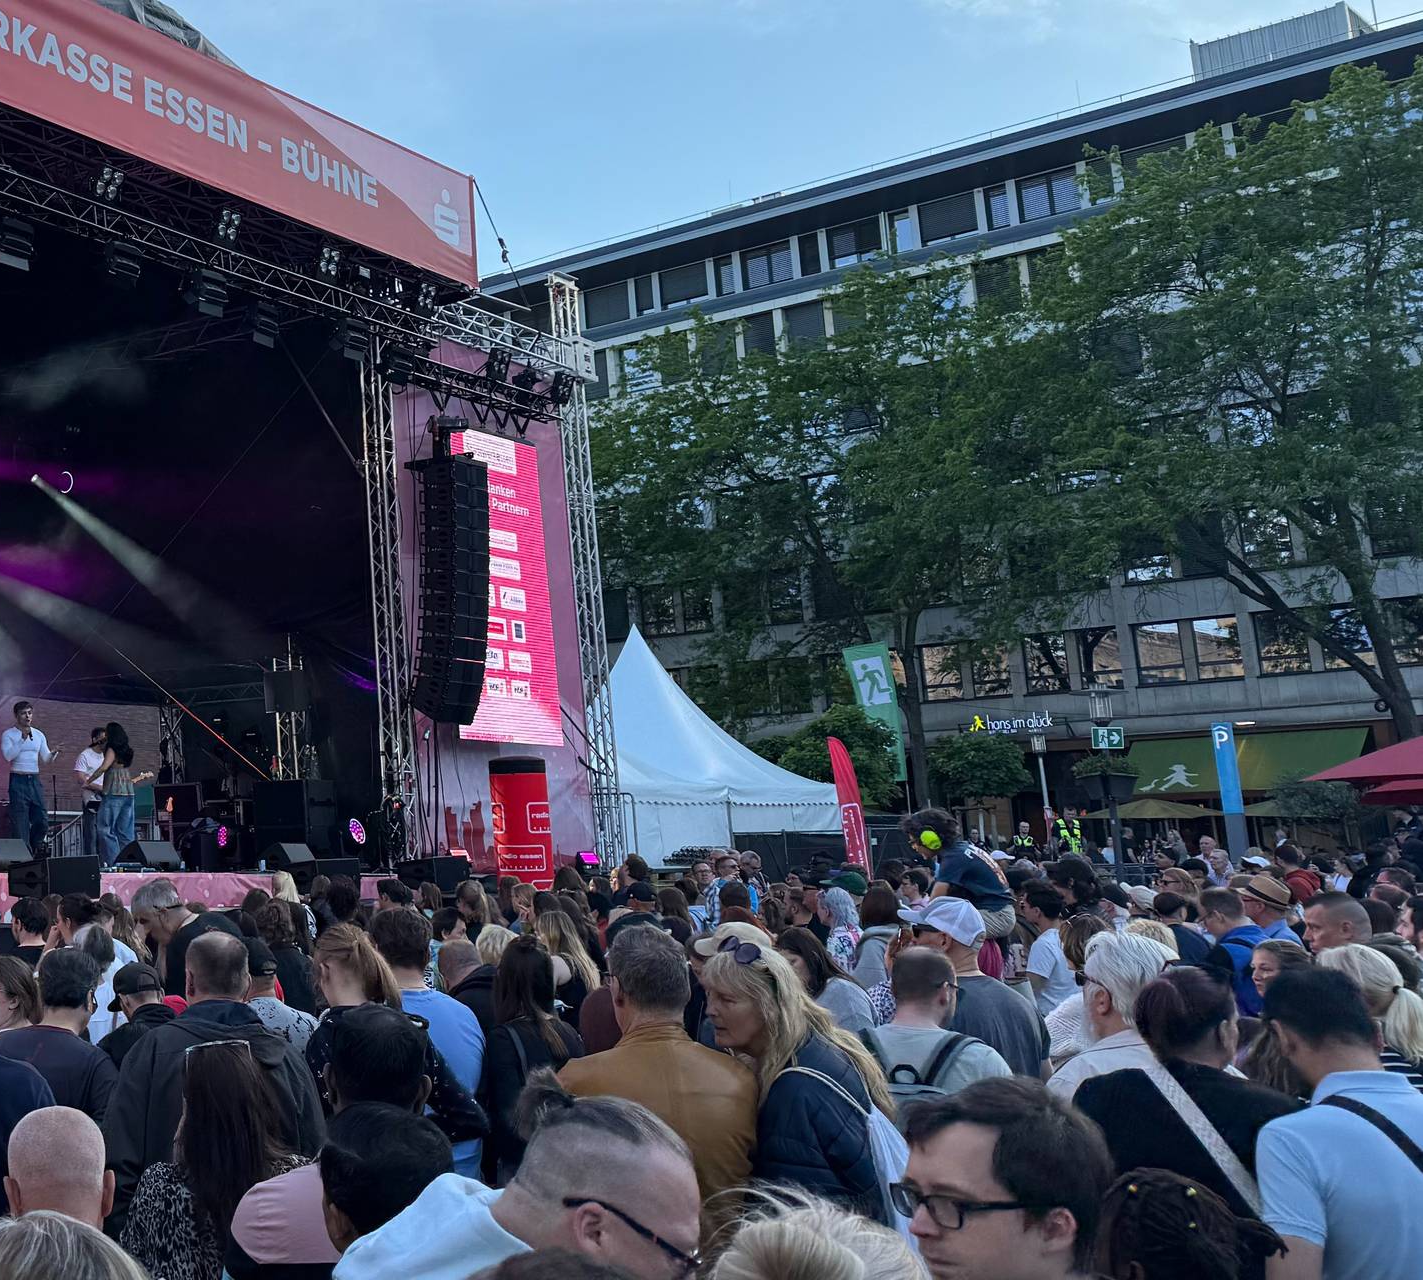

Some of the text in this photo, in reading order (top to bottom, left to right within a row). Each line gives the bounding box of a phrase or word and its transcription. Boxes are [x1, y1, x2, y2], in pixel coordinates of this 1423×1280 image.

[144, 75, 248, 153] ESSEN
[281, 136, 378, 208] BÜHNE
[488, 484, 516, 498] anken
[986, 714, 1011, 730] hans
[1012, 717, 1026, 729] im
[1214, 731, 1229, 749] P
